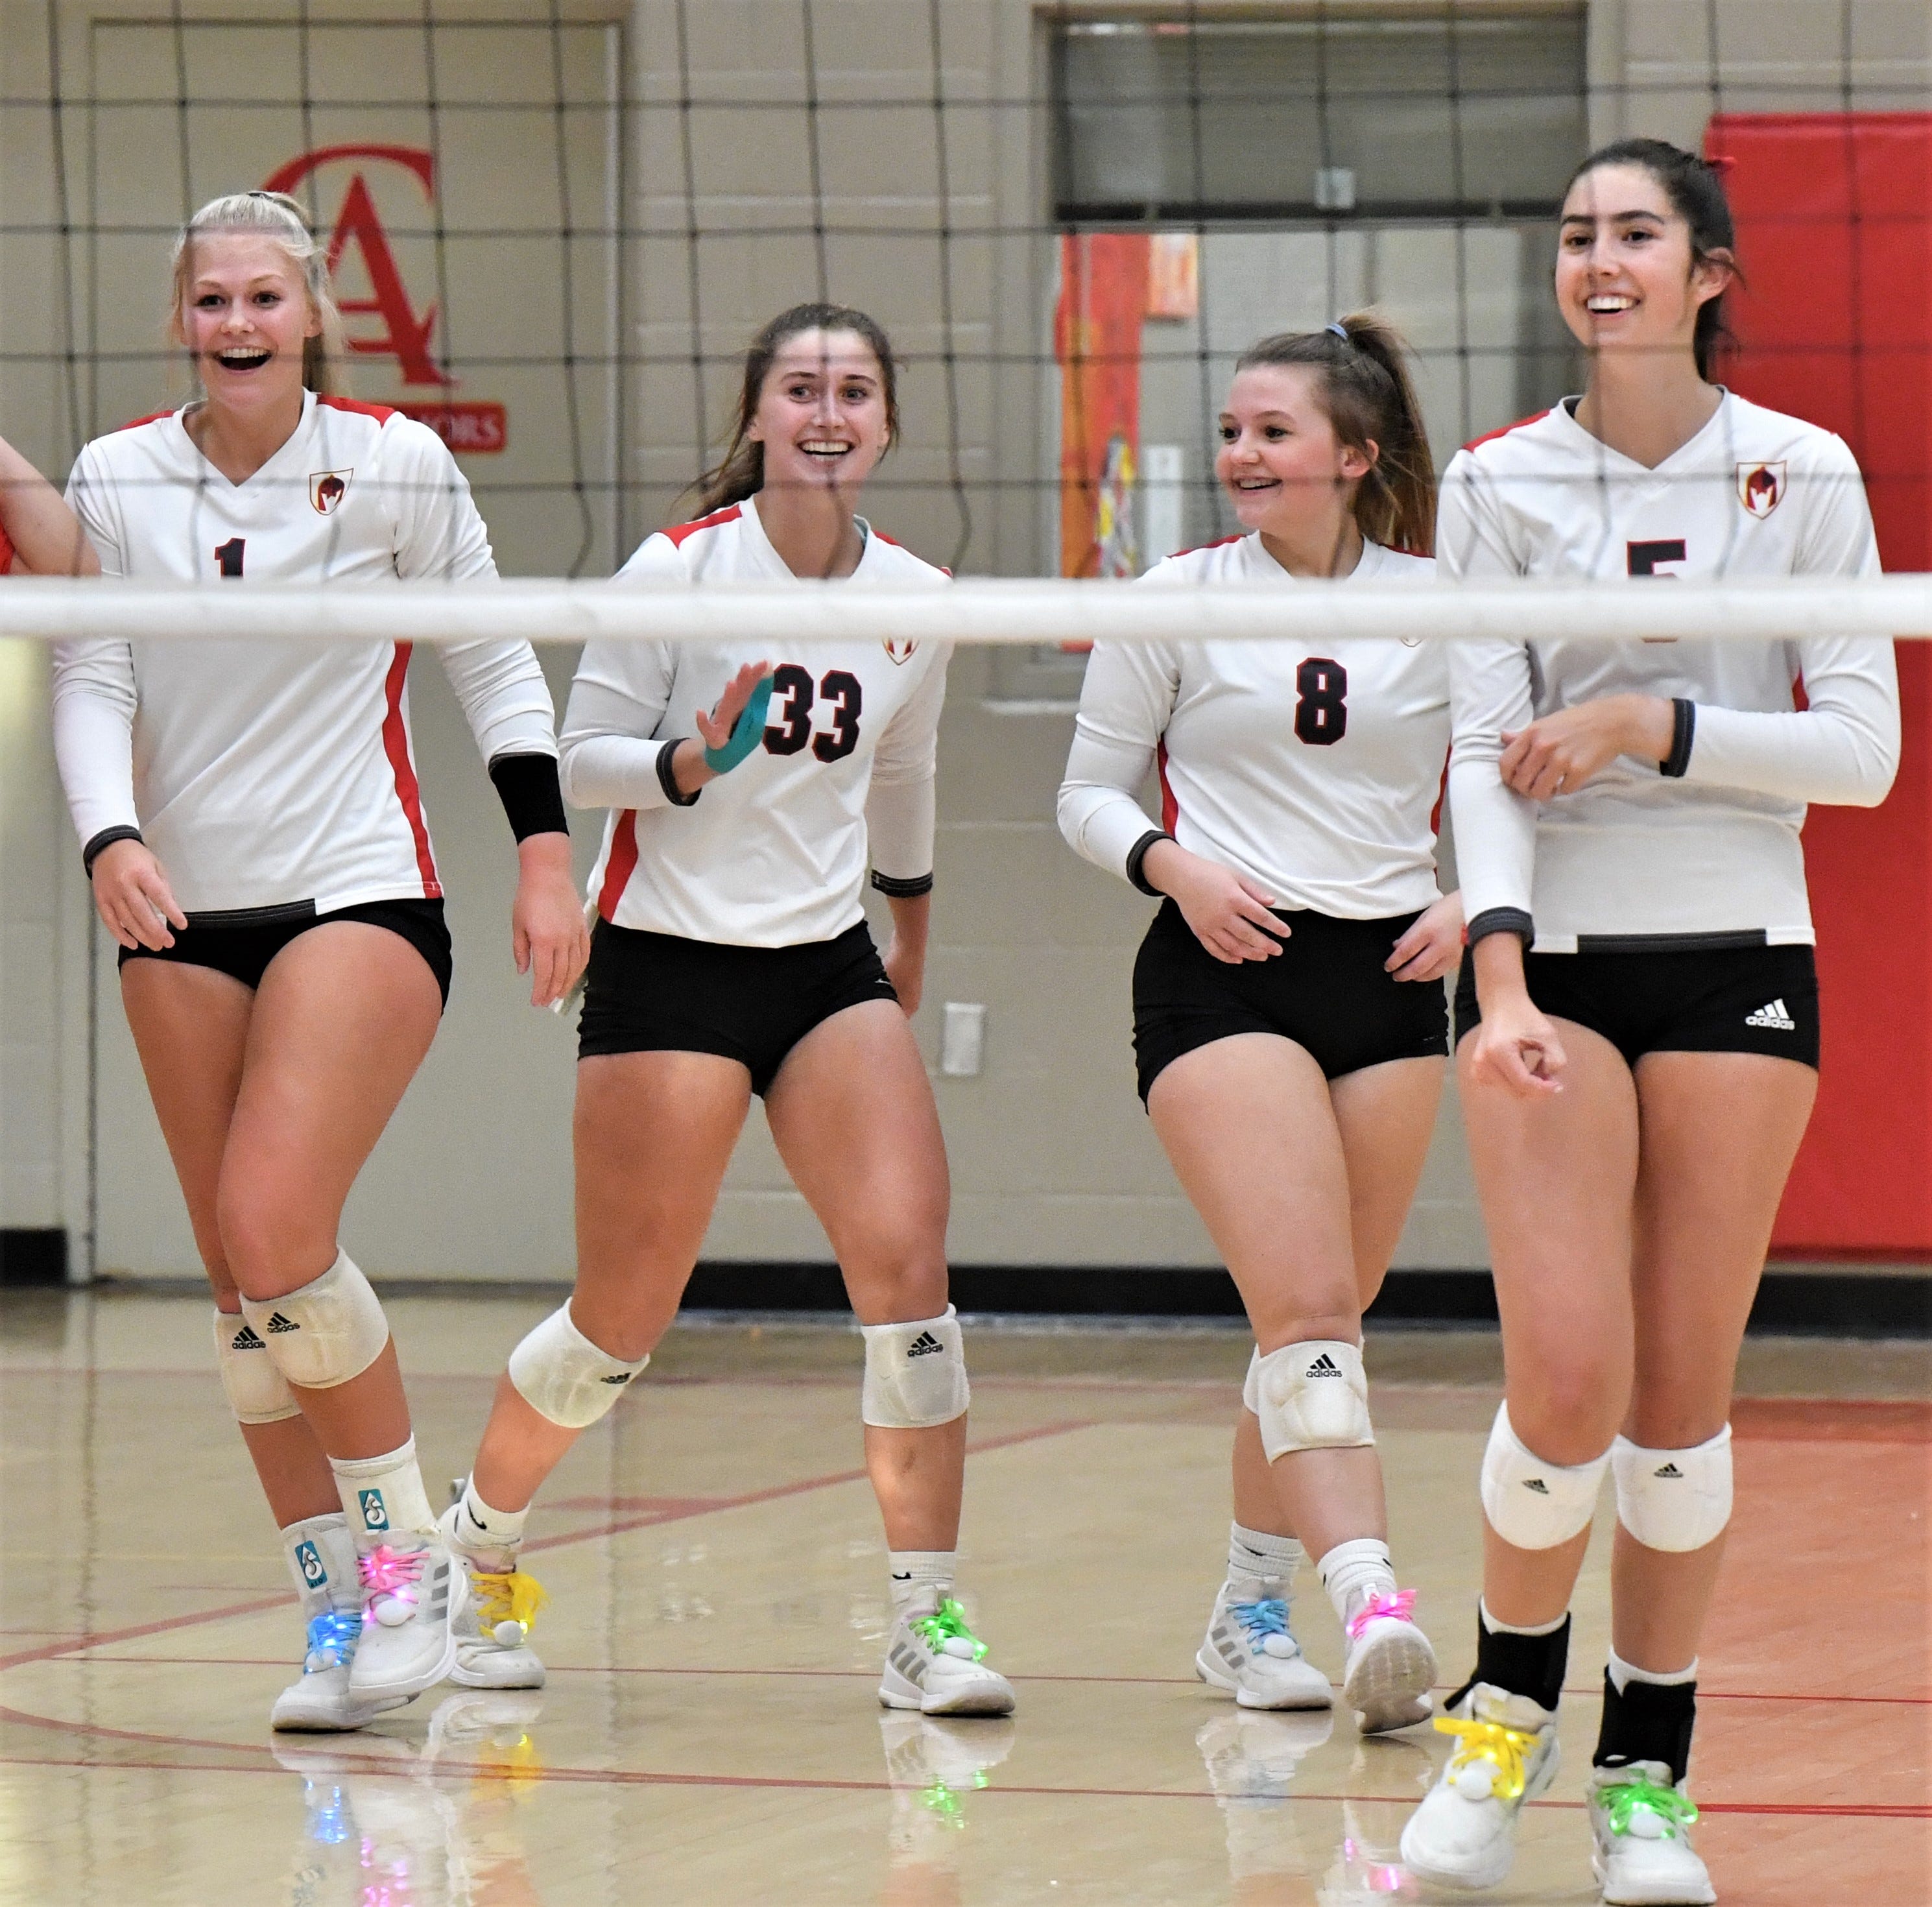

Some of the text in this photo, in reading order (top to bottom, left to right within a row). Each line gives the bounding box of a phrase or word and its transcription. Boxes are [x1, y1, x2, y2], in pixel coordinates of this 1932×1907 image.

[1294, 657, 1348, 746] 8
[762, 663, 862, 763] 33
[1745, 1016, 1795, 1031] adidas
[267, 1323, 300, 1334] adidas
[232, 1340, 267, 1349] adidas
[907, 1343, 944, 1357] adidas
[1306, 1369, 1342, 1378] adidas
